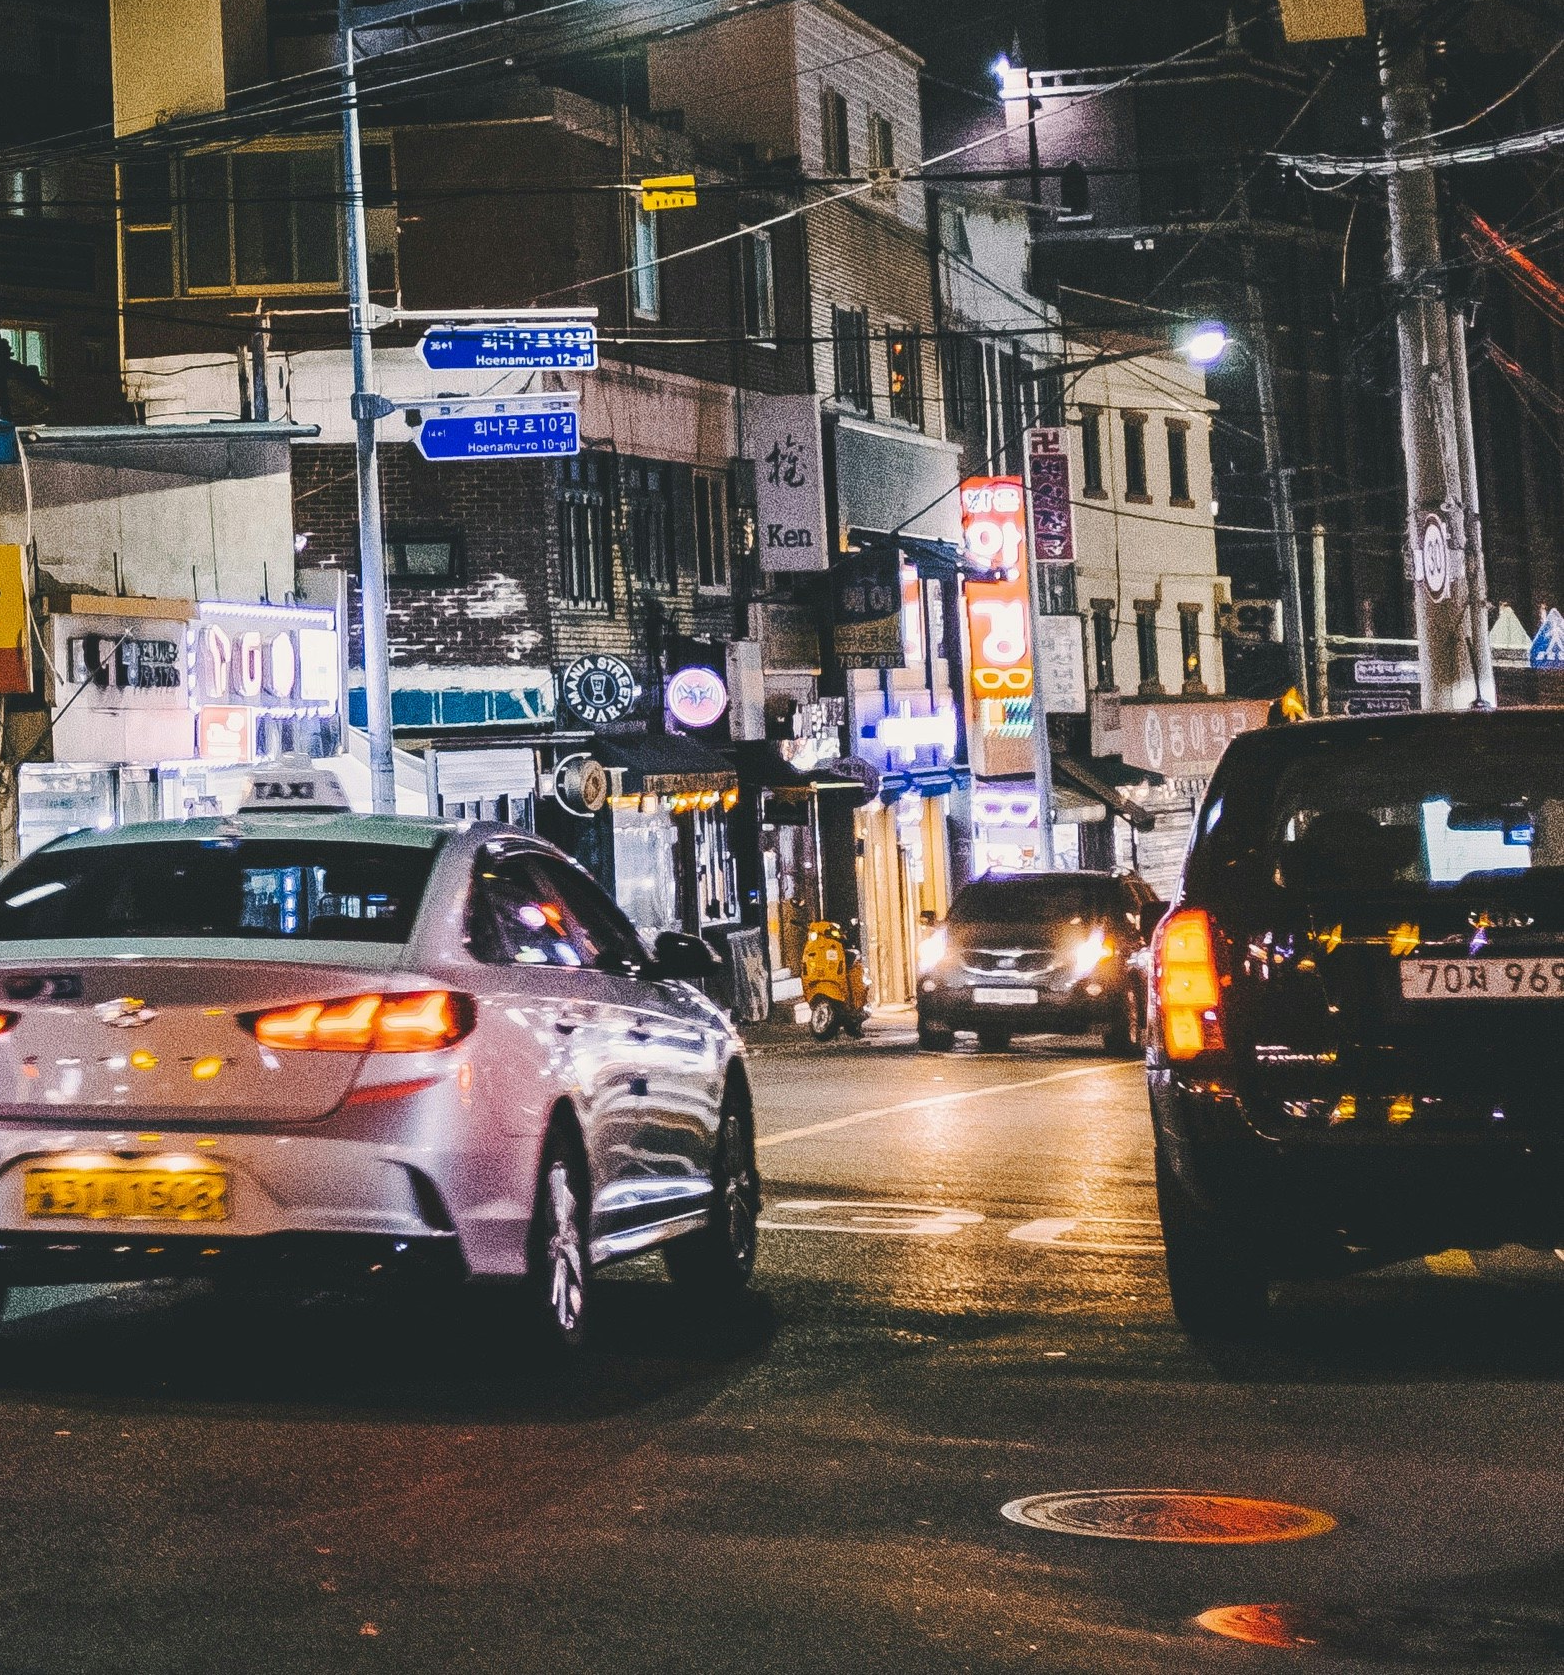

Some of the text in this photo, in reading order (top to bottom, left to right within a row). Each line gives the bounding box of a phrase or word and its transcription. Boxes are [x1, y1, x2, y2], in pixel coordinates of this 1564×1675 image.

[475, 353, 592, 367] Hoenamu-ro 12-gil
[472, 415, 574, 437] 회나무로10길
[467, 438, 574, 454] Hoenamu-ro 10-gil
[766, 524, 814, 549] Ken
[565, 655, 633, 709] MANIA STREET
[581, 705, 621, 723] BAR
[254, 780, 316, 800] TAXI
